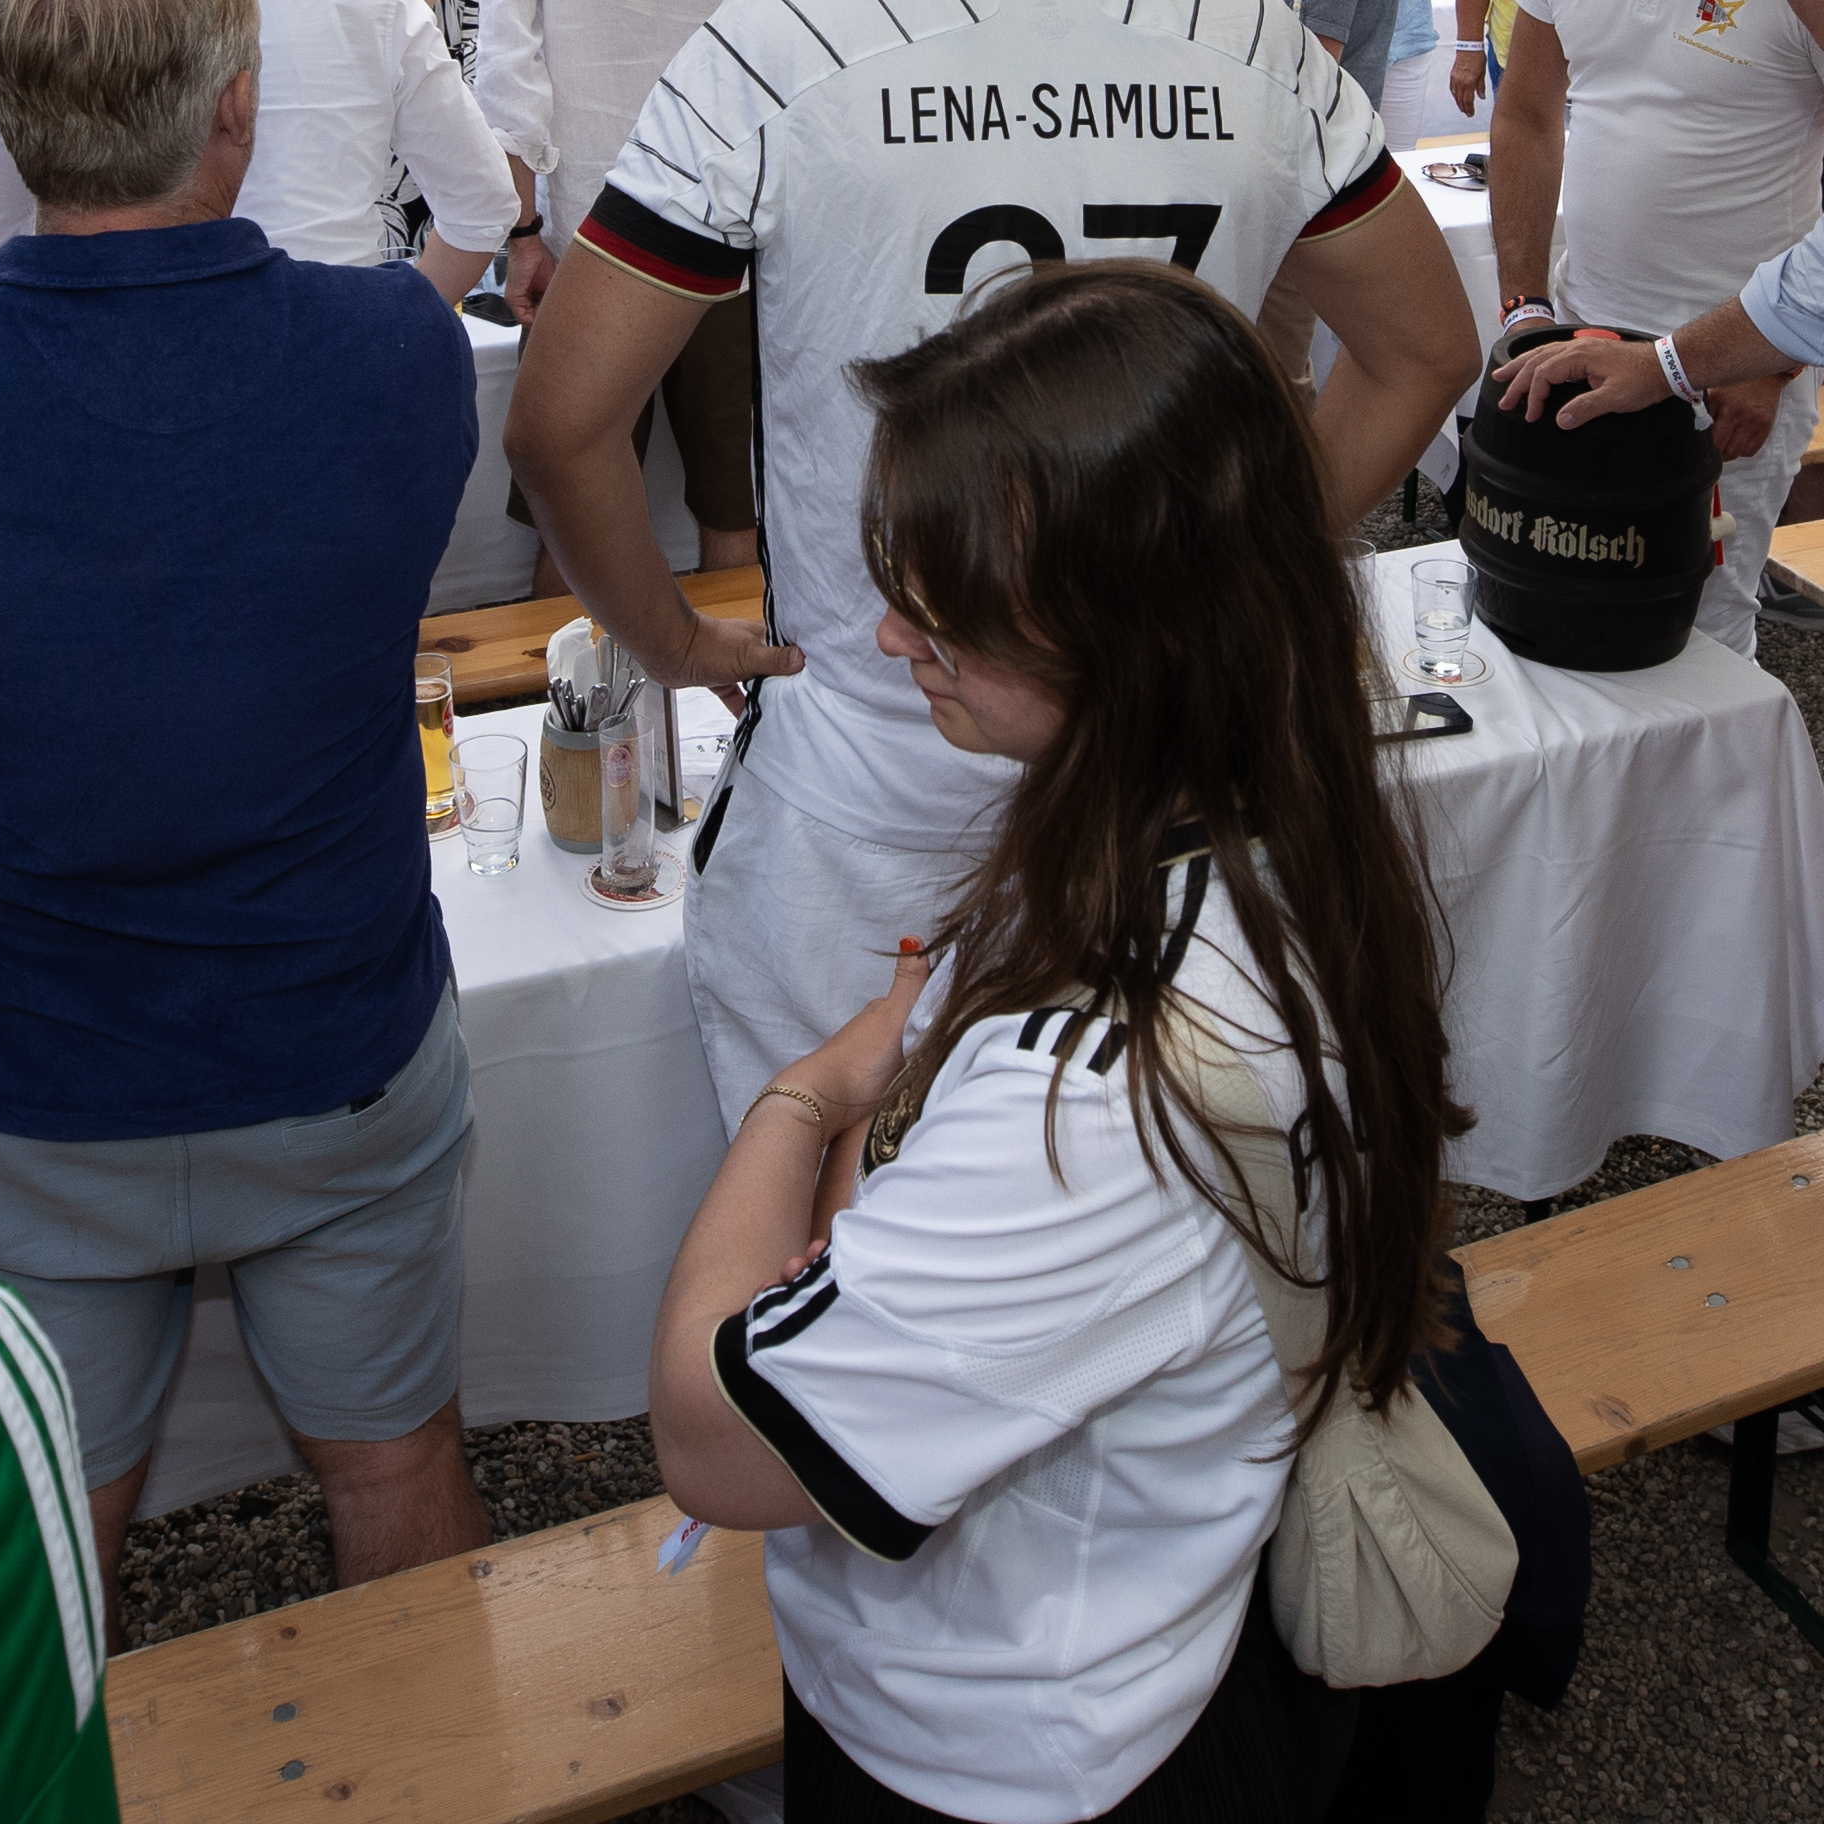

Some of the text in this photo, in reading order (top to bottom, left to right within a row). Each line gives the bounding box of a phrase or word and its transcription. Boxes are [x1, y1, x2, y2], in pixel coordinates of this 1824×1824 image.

[881, 82, 1235, 144] LENA-SAMUEL
[1664, 349, 1683, 382] 29.06.24
[1529, 515, 1645, 569] Kölsch
